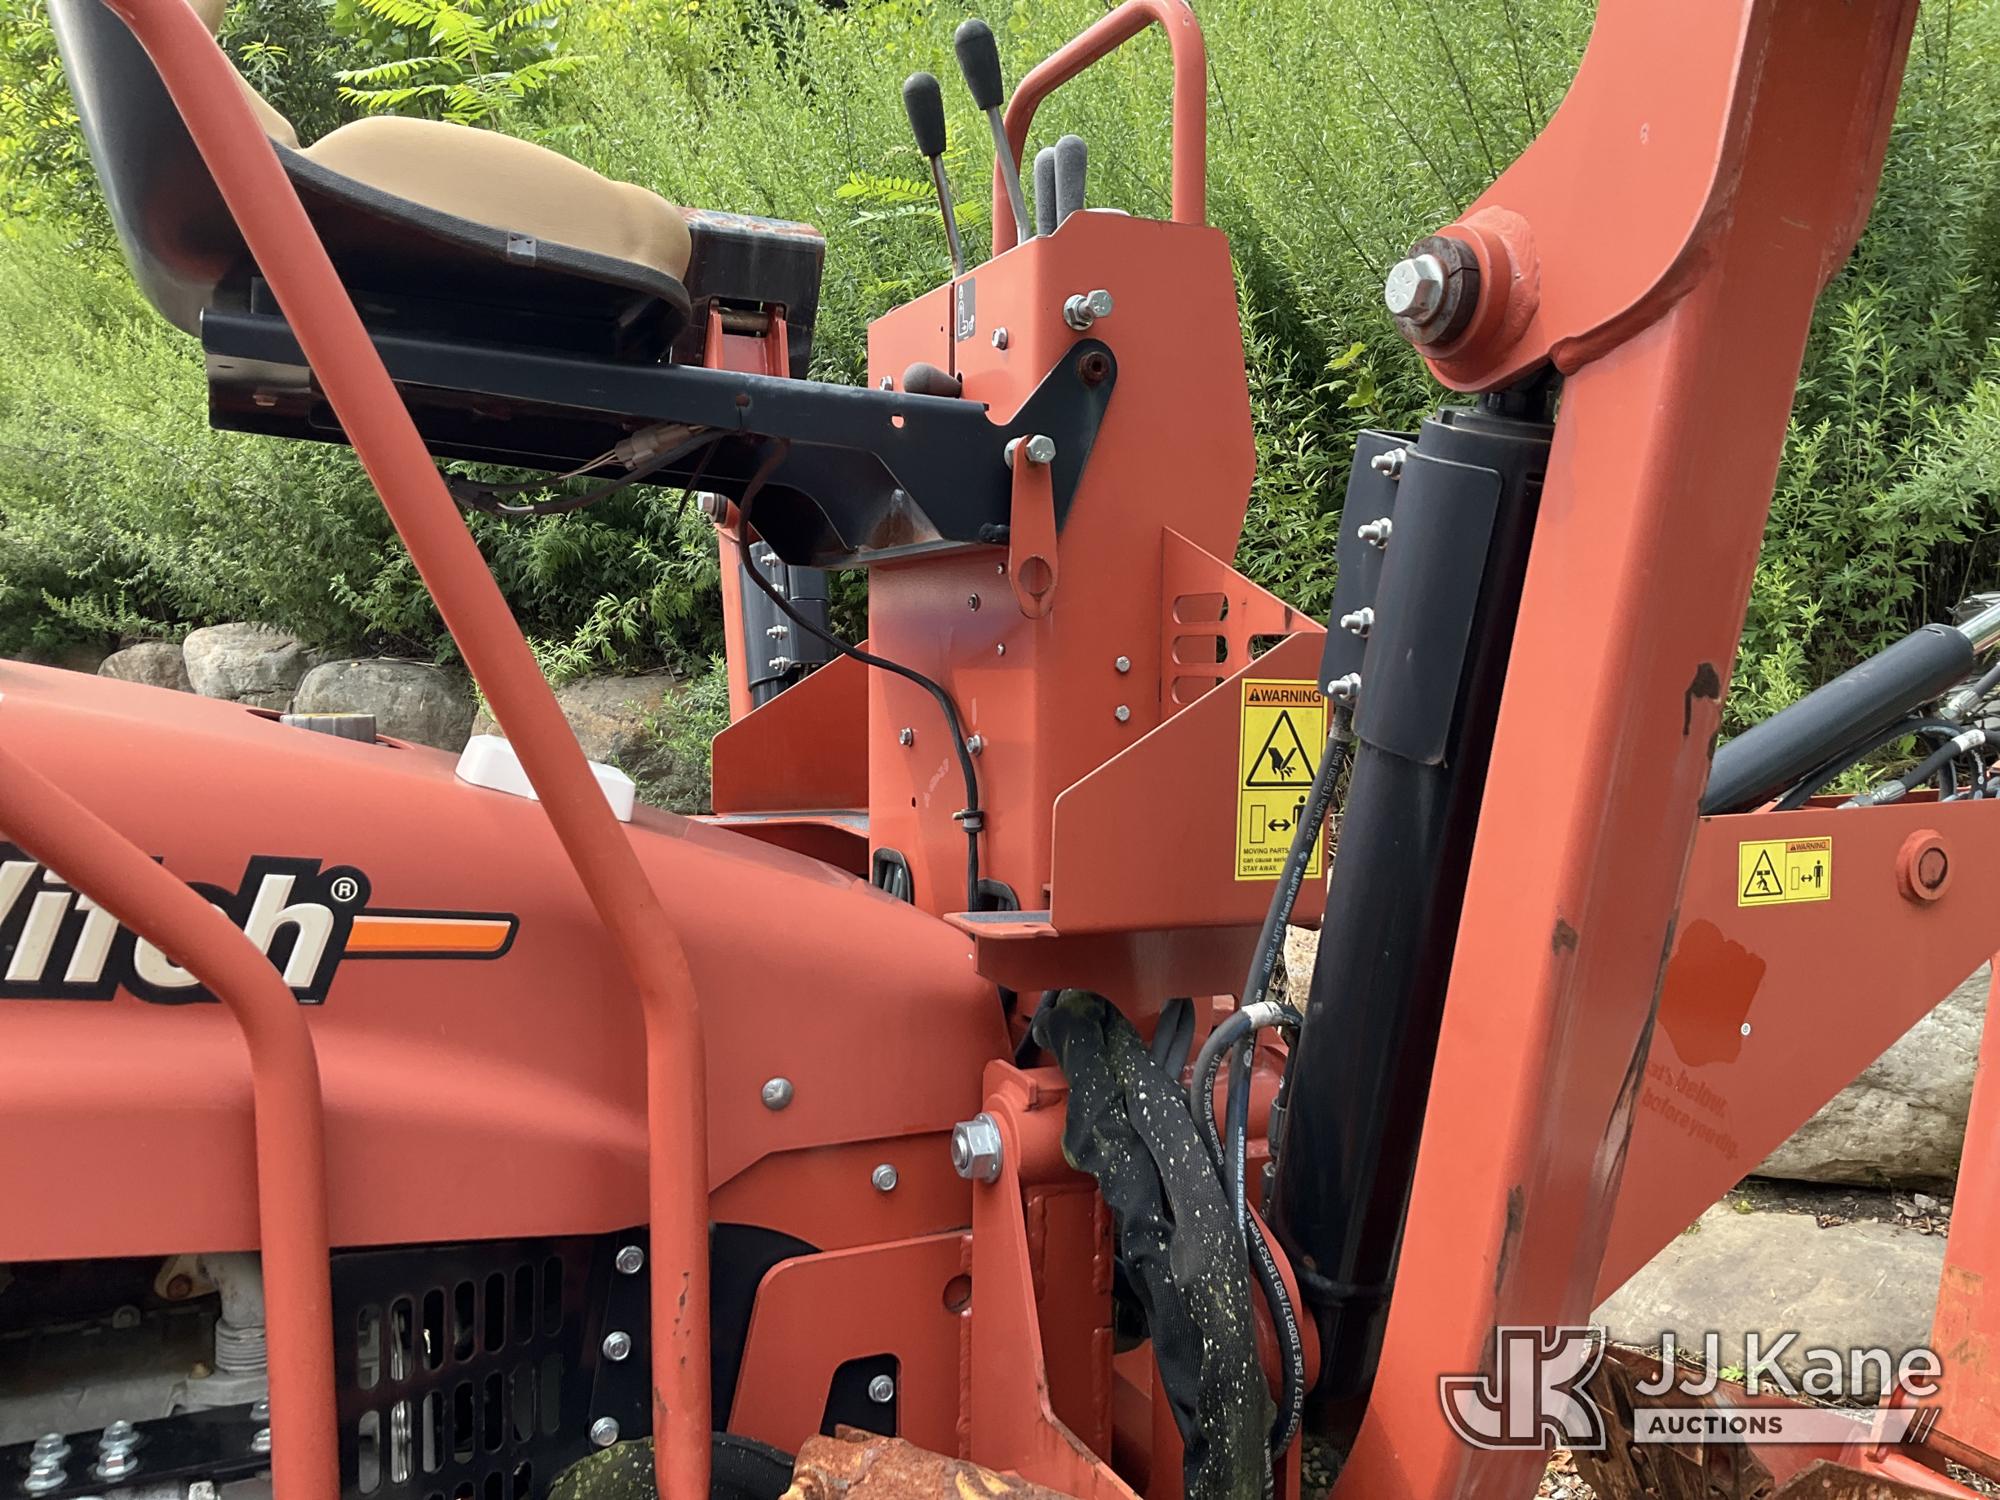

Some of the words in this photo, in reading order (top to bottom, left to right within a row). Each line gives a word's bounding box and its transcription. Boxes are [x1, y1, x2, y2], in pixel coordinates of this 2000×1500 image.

[1260, 689, 1321, 703] WARNING
[1796, 842, 1826, 850] WARNING
[0, 861, 334, 987] ith
[1237, 1183, 1245, 1230] POWERING
[1259, 1245, 1280, 1279] 18752
[1274, 1281, 1287, 1300] ISO
[1293, 1353, 1304, 1376] SAE
